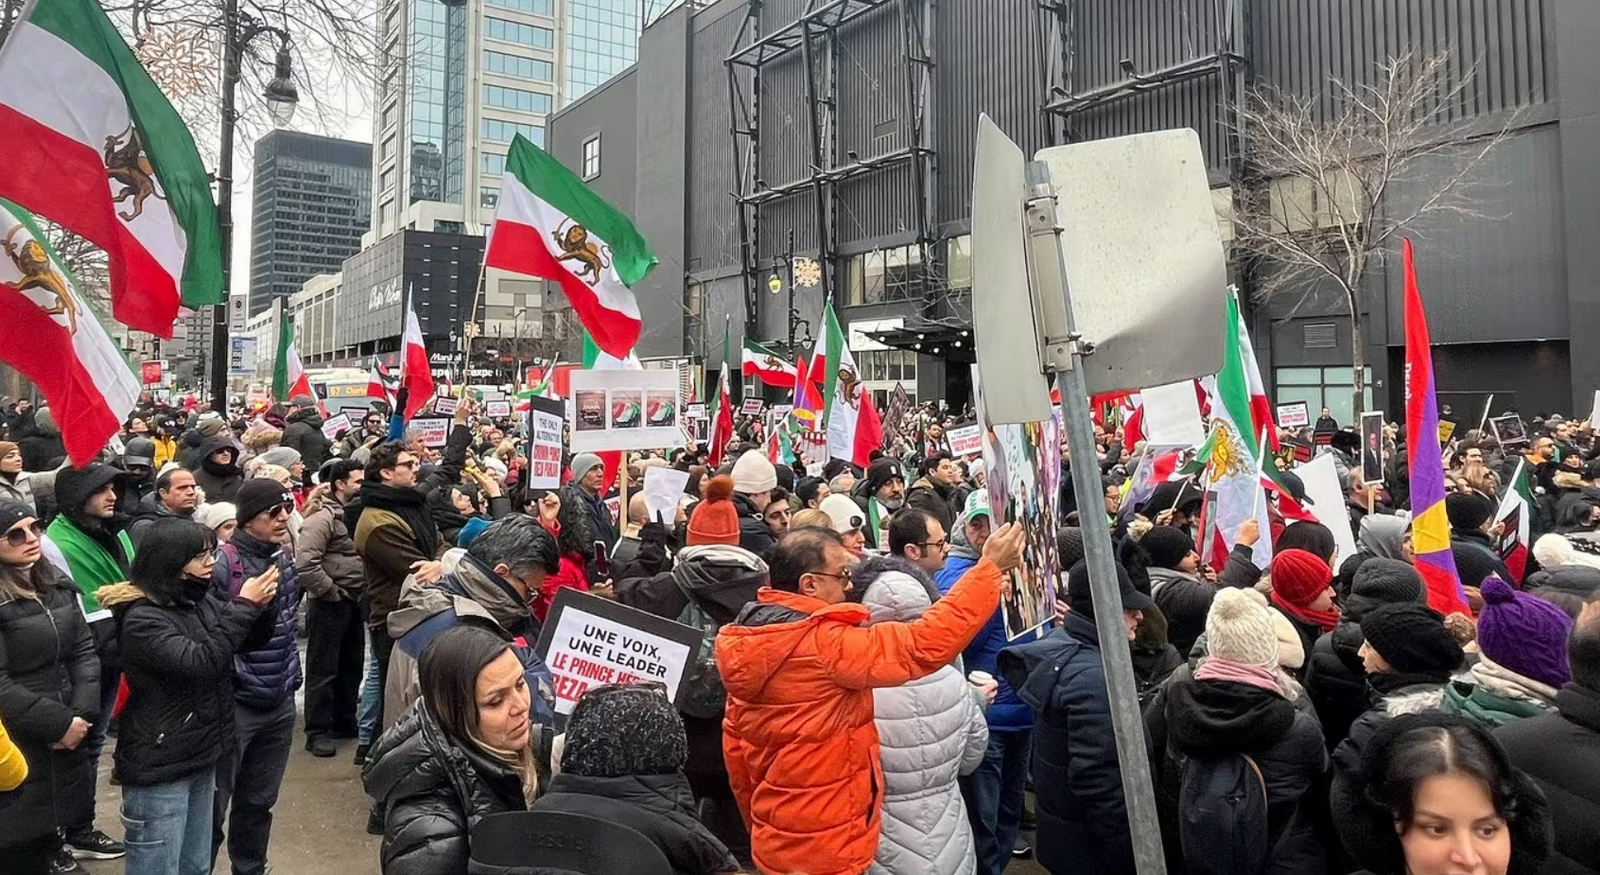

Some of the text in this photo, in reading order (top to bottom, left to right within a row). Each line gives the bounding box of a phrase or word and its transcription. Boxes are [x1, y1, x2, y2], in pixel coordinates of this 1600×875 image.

[568, 637, 667, 678] UNE LEADER
[583, 624, 662, 662] UNE VOIX,
[552, 652, 568, 671] LE
[568, 657, 616, 684] PRINCE
